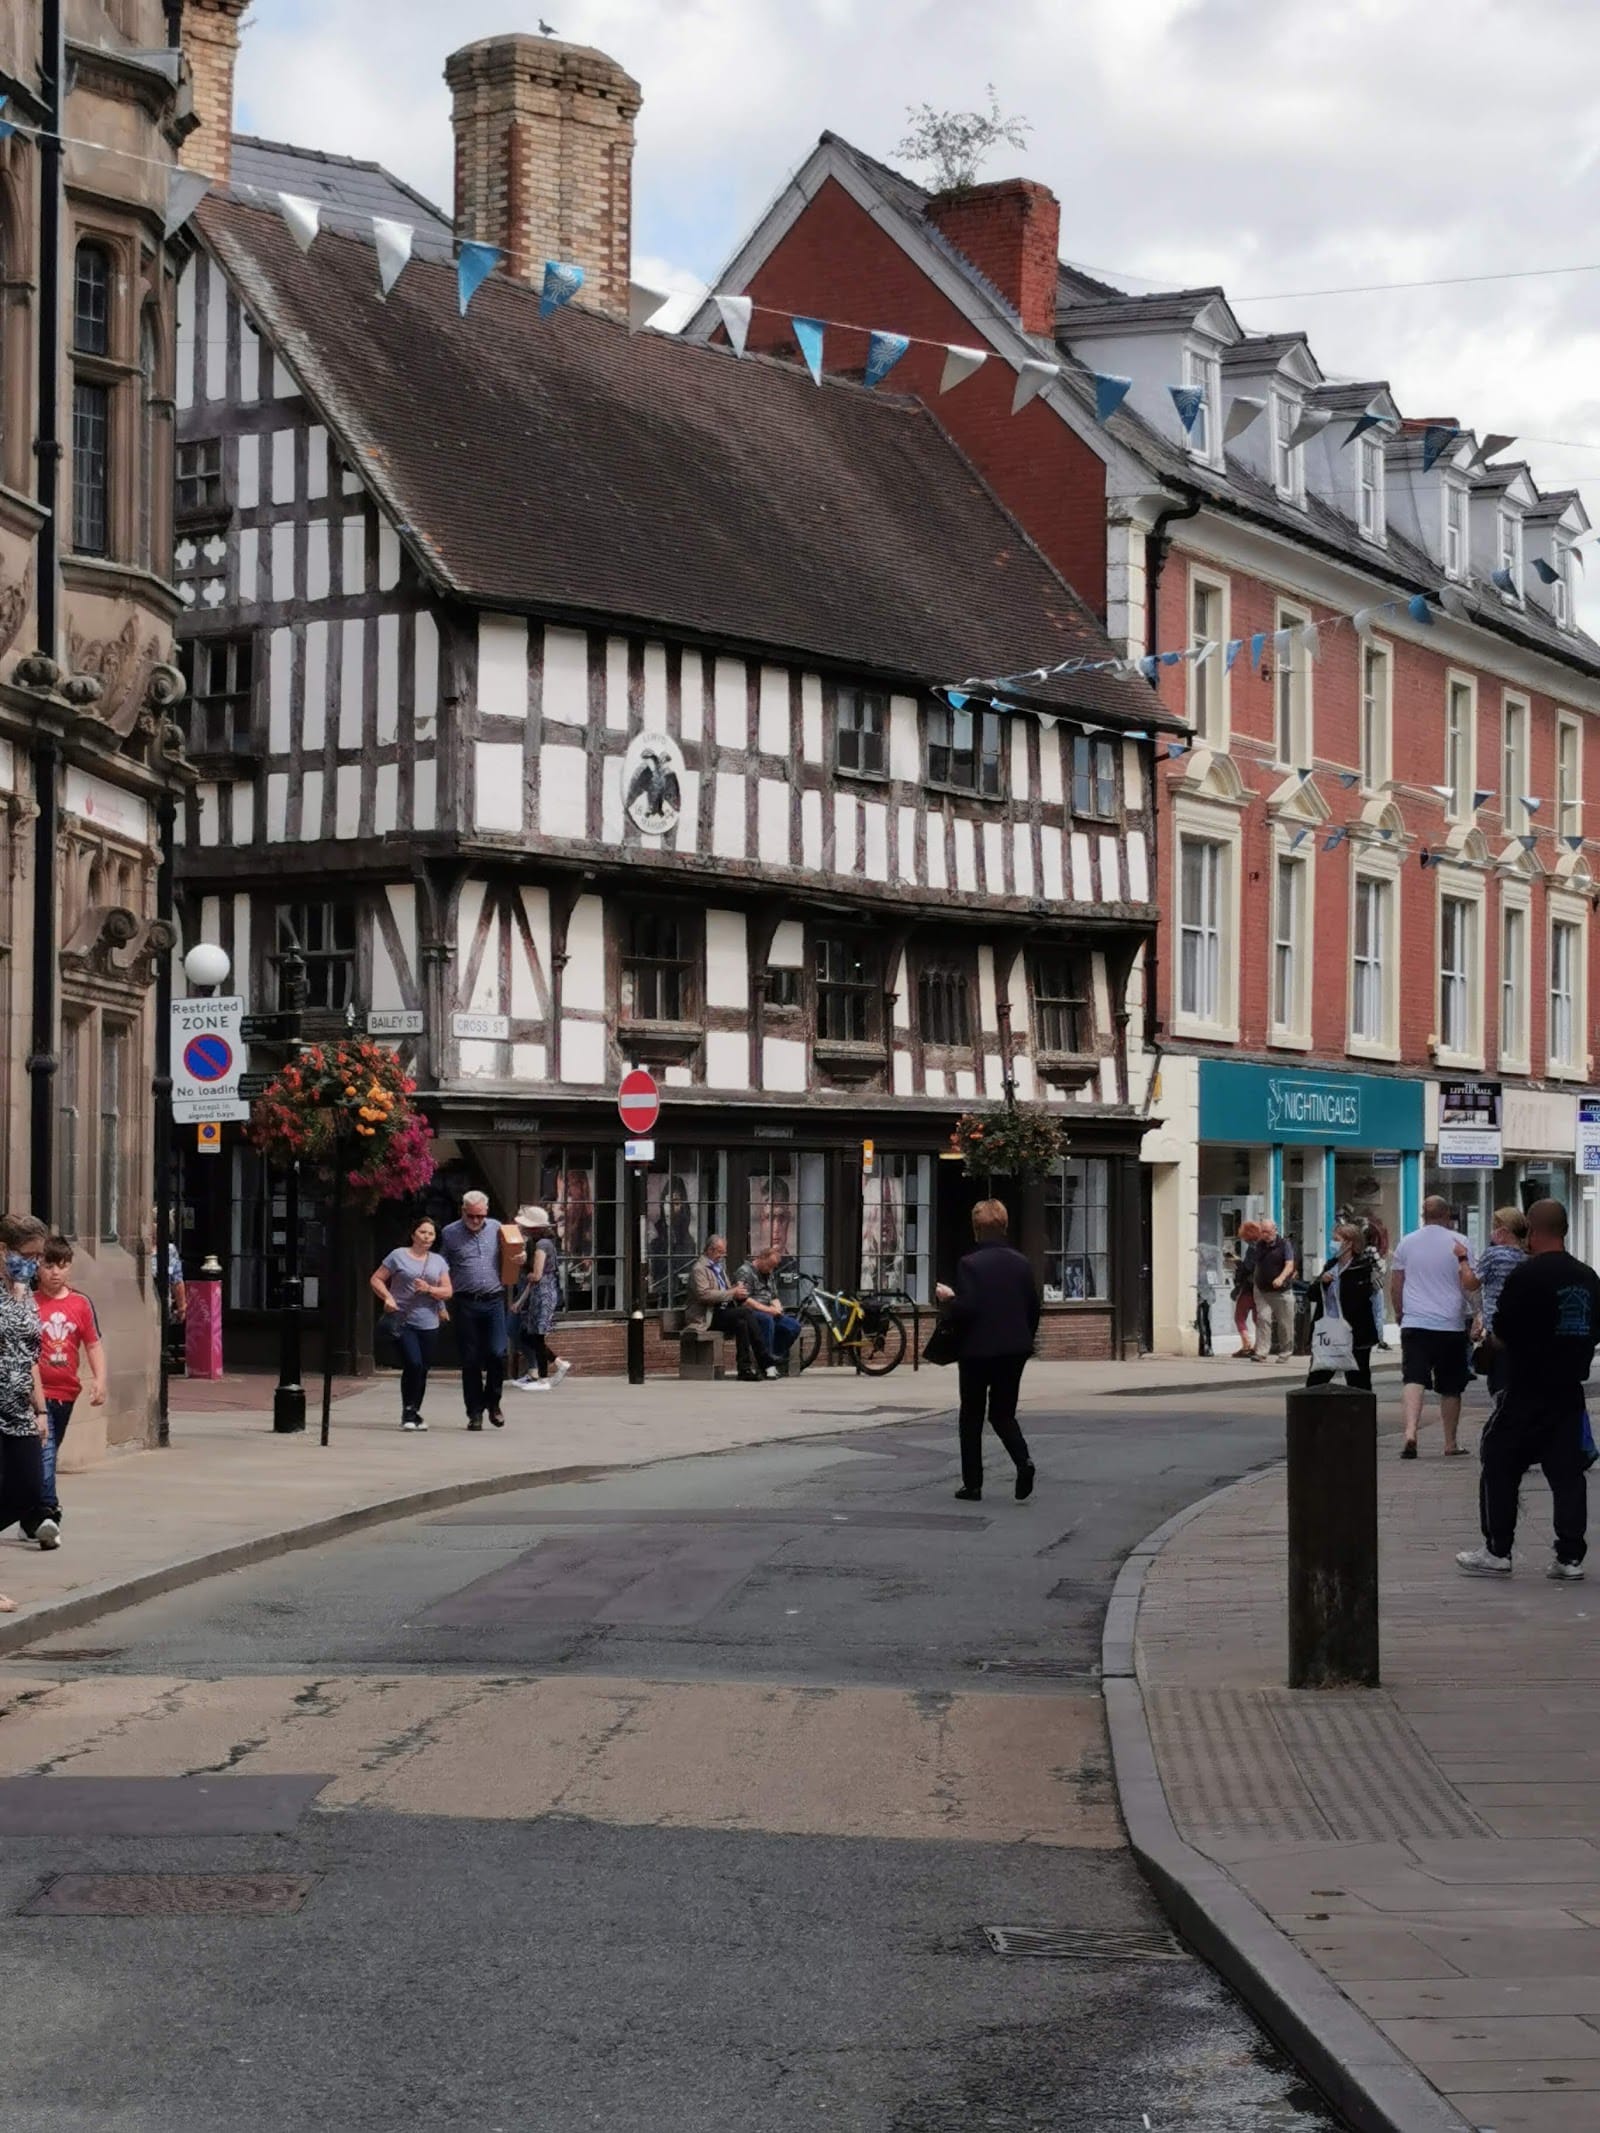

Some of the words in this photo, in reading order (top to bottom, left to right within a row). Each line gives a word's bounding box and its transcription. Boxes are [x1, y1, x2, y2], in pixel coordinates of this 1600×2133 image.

[172, 1002, 238, 1014] Restricted
[182, 1016, 229, 1030] ZONE
[371, 1015, 402, 1028] BAILEY
[457, 1019, 489, 1032] CROSS
[177, 1087, 193, 1096] No
[199, 1085, 239, 1096] loadin
[1284, 1092, 1357, 1124] NIGHTINGALES
[188, 1112, 214, 1120] signed
[1316, 1331, 1330, 1346] Tu
